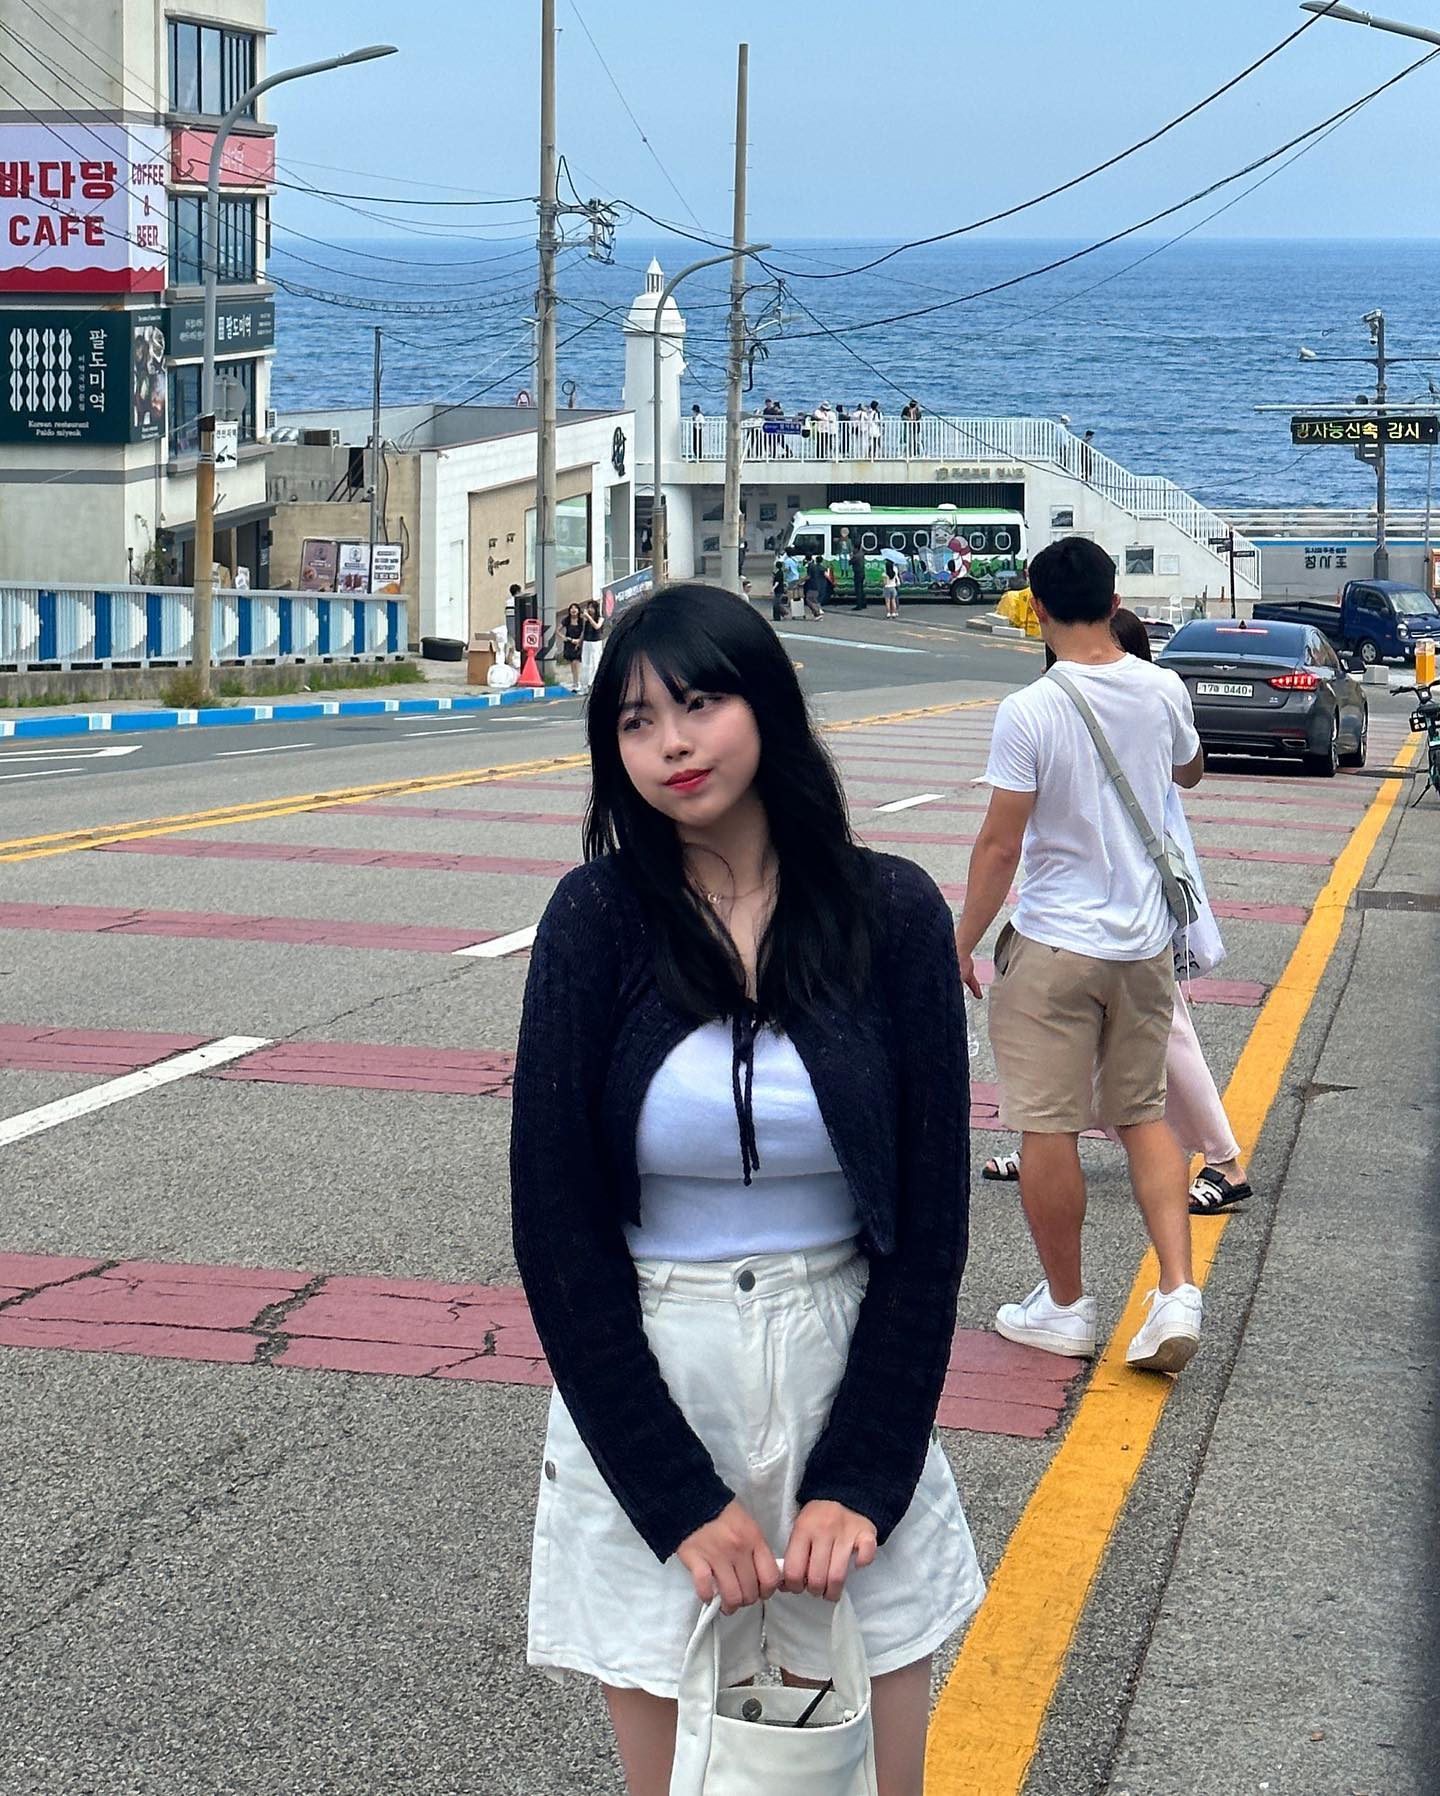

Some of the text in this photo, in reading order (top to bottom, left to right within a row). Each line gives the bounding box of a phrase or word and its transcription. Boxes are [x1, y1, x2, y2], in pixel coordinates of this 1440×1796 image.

[0, 161, 118, 199] 바다당
[131, 164, 164, 185] COFFEE
[144, 195, 150, 216] &
[9, 215, 105, 246] CAFE
[136, 225, 159, 246] BEER
[226, 314, 251, 340] 팔도미역
[89, 329, 107, 412] 팔도미역
[28, 420, 52, 428] Korean
[1387, 422, 1420, 439] 감시
[1224, 685, 1248, 696] 0440
